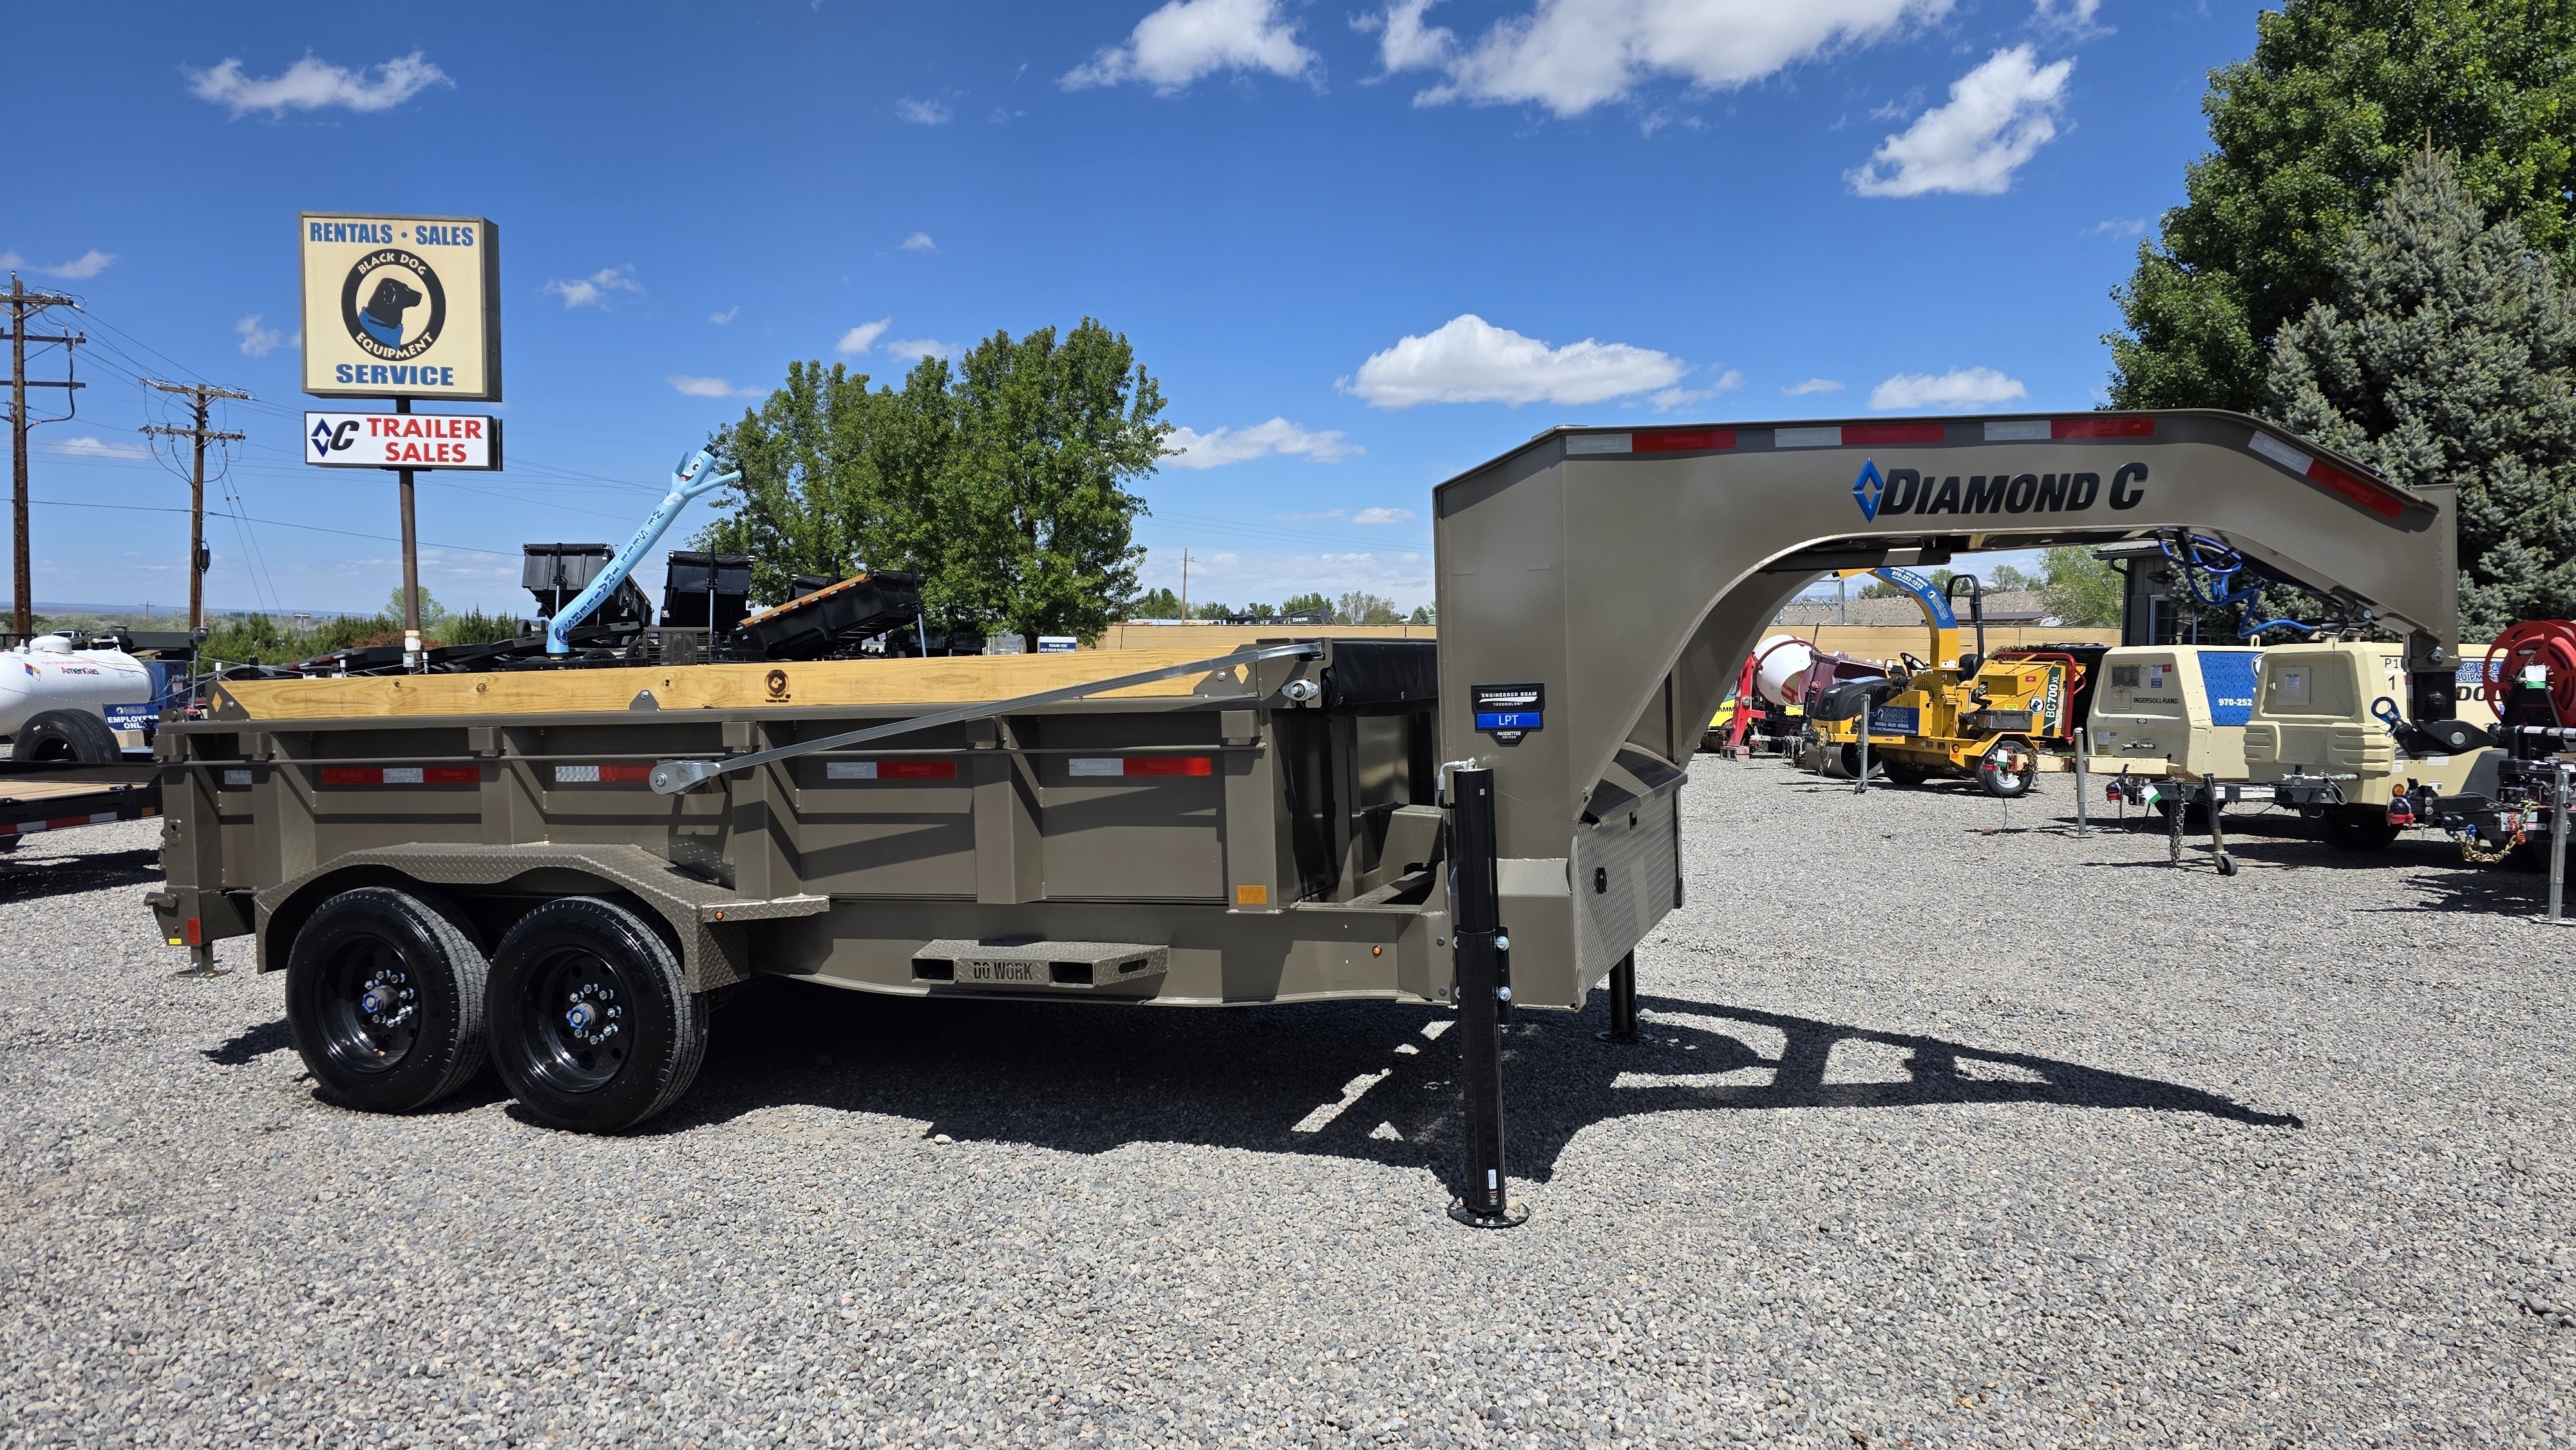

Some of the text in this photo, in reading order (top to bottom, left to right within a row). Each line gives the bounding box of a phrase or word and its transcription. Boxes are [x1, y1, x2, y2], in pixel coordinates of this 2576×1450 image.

[310, 222, 474, 247] RENTALS SALES
[357, 252, 426, 276] BLACK DOG
[355, 332, 433, 359] EQUIPMENT
[336, 364, 454, 386] SERVICE
[330, 420, 360, 451] C
[366, 417, 483, 439] TRAILER
[384, 442, 467, 464] SALES
[1877, 462, 2149, 515] DIAMOND C
[648, 509, 665, 527] WE
[621, 530, 649, 563] SELL
[564, 565, 622, 629] TRAILERS
[61, 666, 100, 675] AmeriGas
[1499, 715, 1519, 726] LPT
[973, 961, 1033, 981] DO WORK
